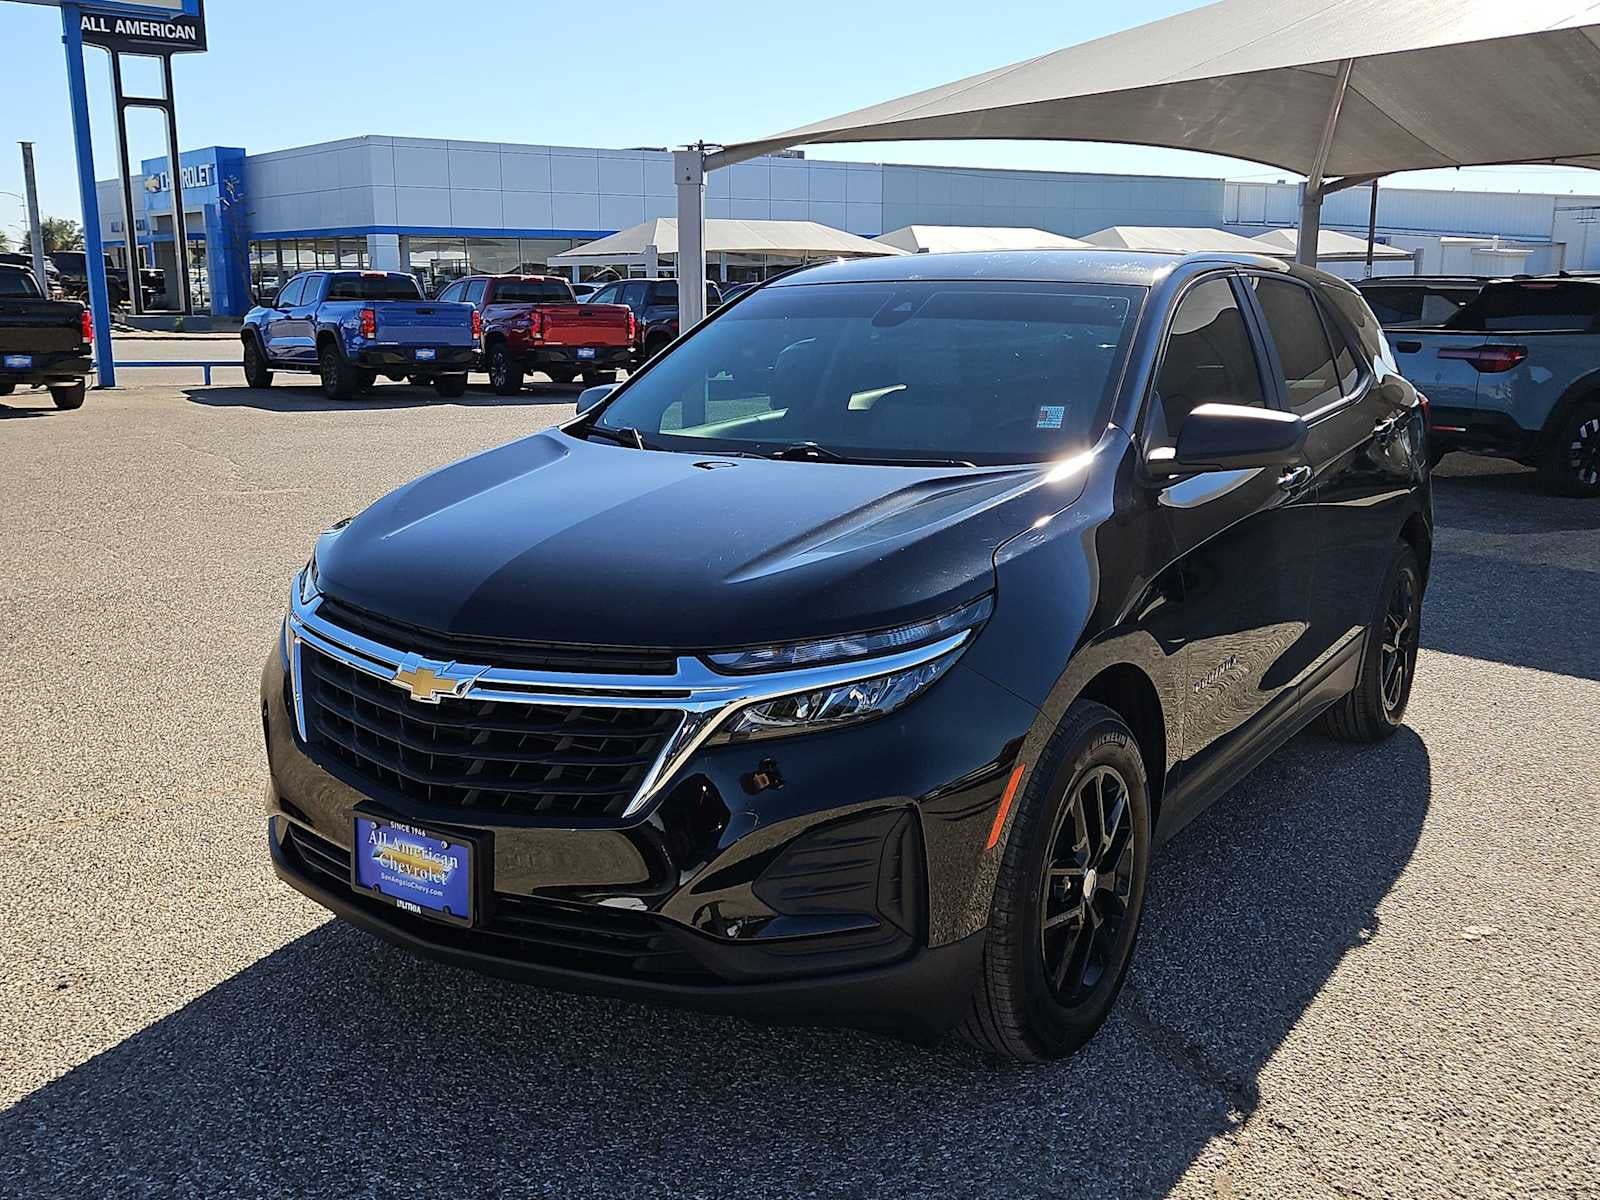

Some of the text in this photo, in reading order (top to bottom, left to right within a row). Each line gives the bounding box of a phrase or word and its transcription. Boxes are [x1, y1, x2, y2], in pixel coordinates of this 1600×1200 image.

[81, 15, 196, 40] ALL AMERICAN
[160, 163, 210, 192] CHROLET
[390, 821, 426, 837] SINCE 1946
[390, 838, 458, 869] American
[379, 852, 449, 886] Chevrolet
